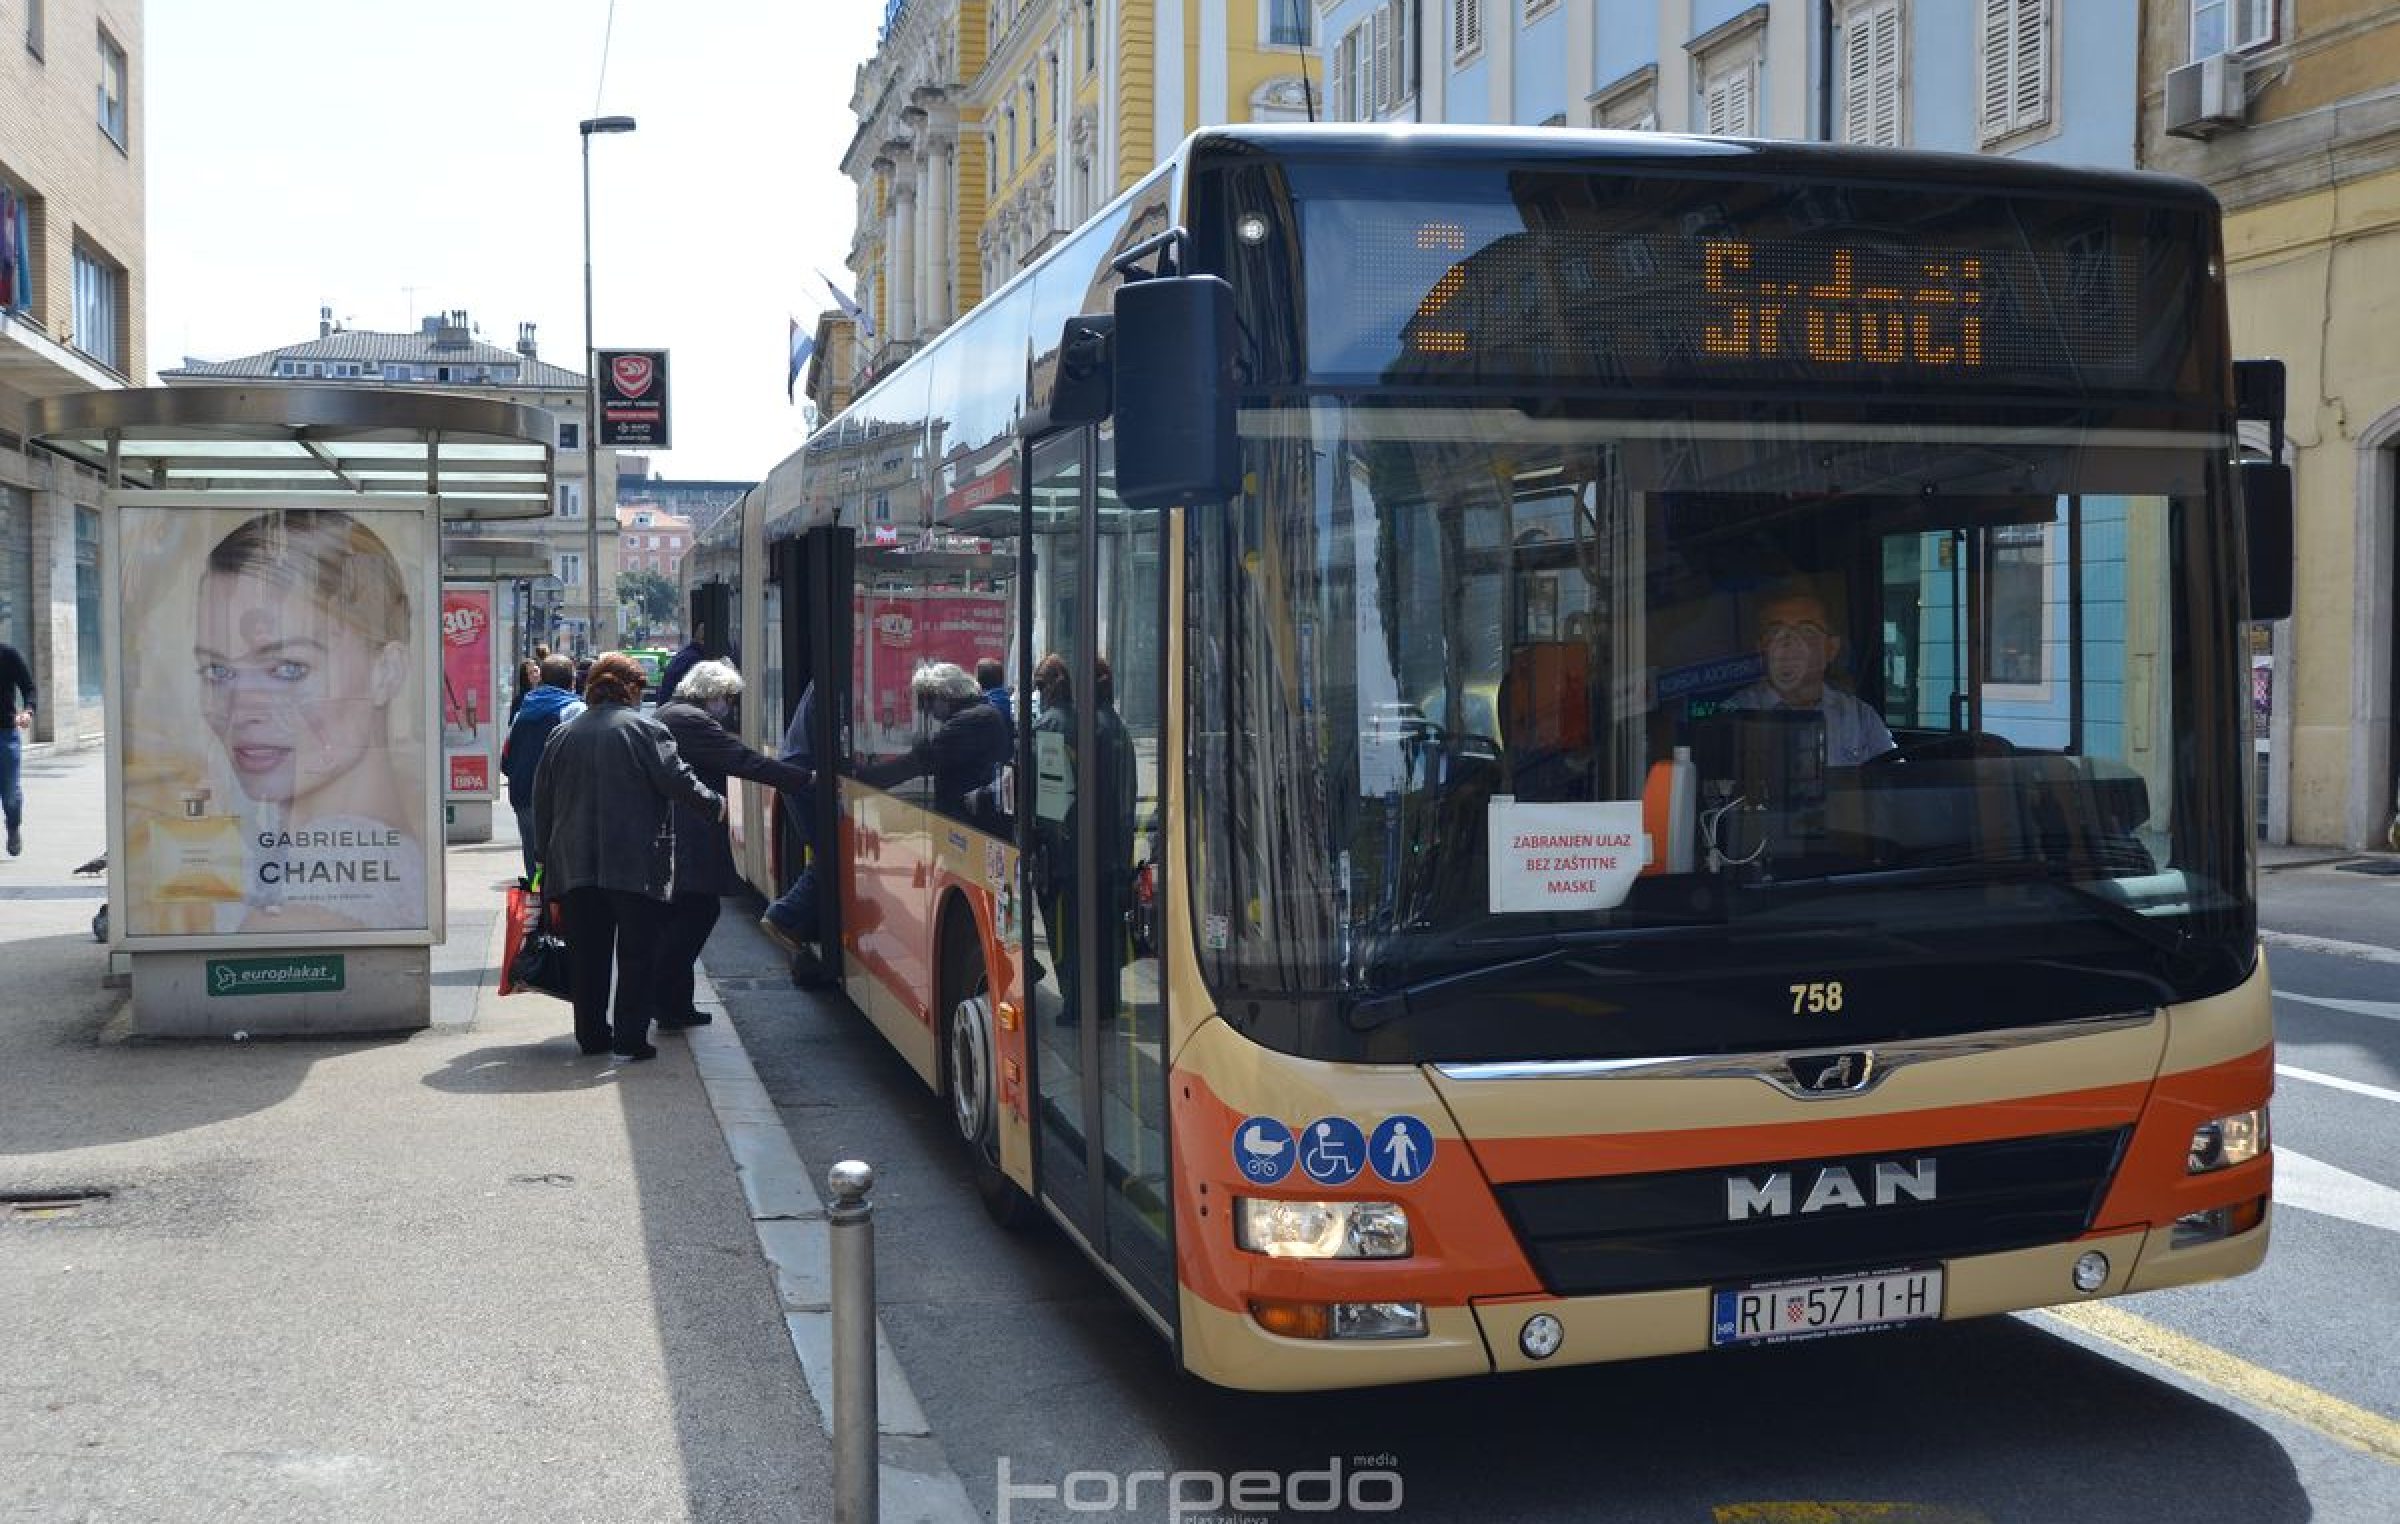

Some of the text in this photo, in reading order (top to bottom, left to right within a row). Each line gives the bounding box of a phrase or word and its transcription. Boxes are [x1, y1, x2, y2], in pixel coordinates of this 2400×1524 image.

[1416, 223, 1465, 351] 2
[258, 829, 401, 848] GABRIELLE
[1513, 833, 1632, 850] ZABRANJEN ULAZ
[259, 859, 401, 885] CHANEL
[1526, 853, 1617, 871] BEZ ZAŠTITNE
[1547, 879, 1597, 894] MASKE
[241, 964, 328, 982] europlakat
[1789, 981, 1844, 1015] 758
[1727, 1157, 1937, 1221] MAN
[1741, 1293, 1777, 1335] RI
